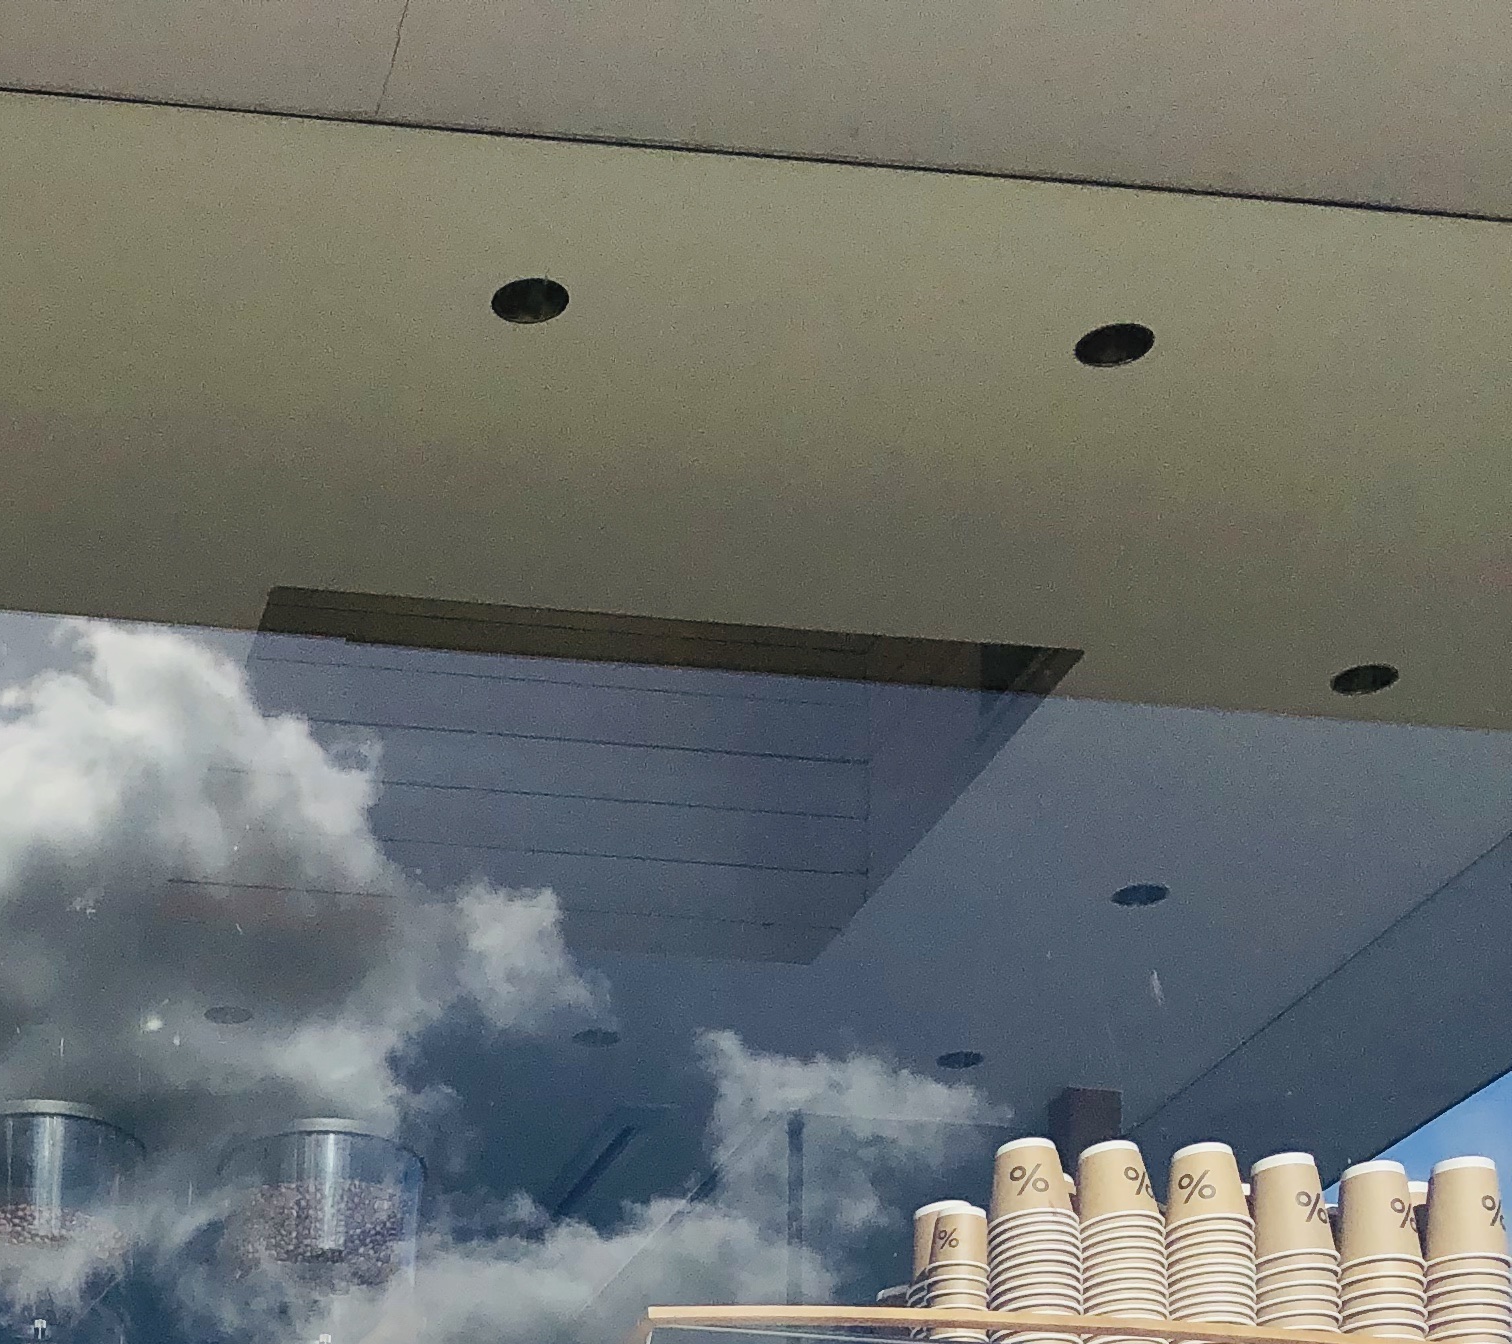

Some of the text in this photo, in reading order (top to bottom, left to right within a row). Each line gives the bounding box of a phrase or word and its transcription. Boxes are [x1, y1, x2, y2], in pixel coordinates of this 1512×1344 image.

[1009, 1163, 1050, 1196] %
[1178, 1169, 1217, 1204] %
[1295, 1191, 1329, 1224] %
[938, 1228, 960, 1249] %
